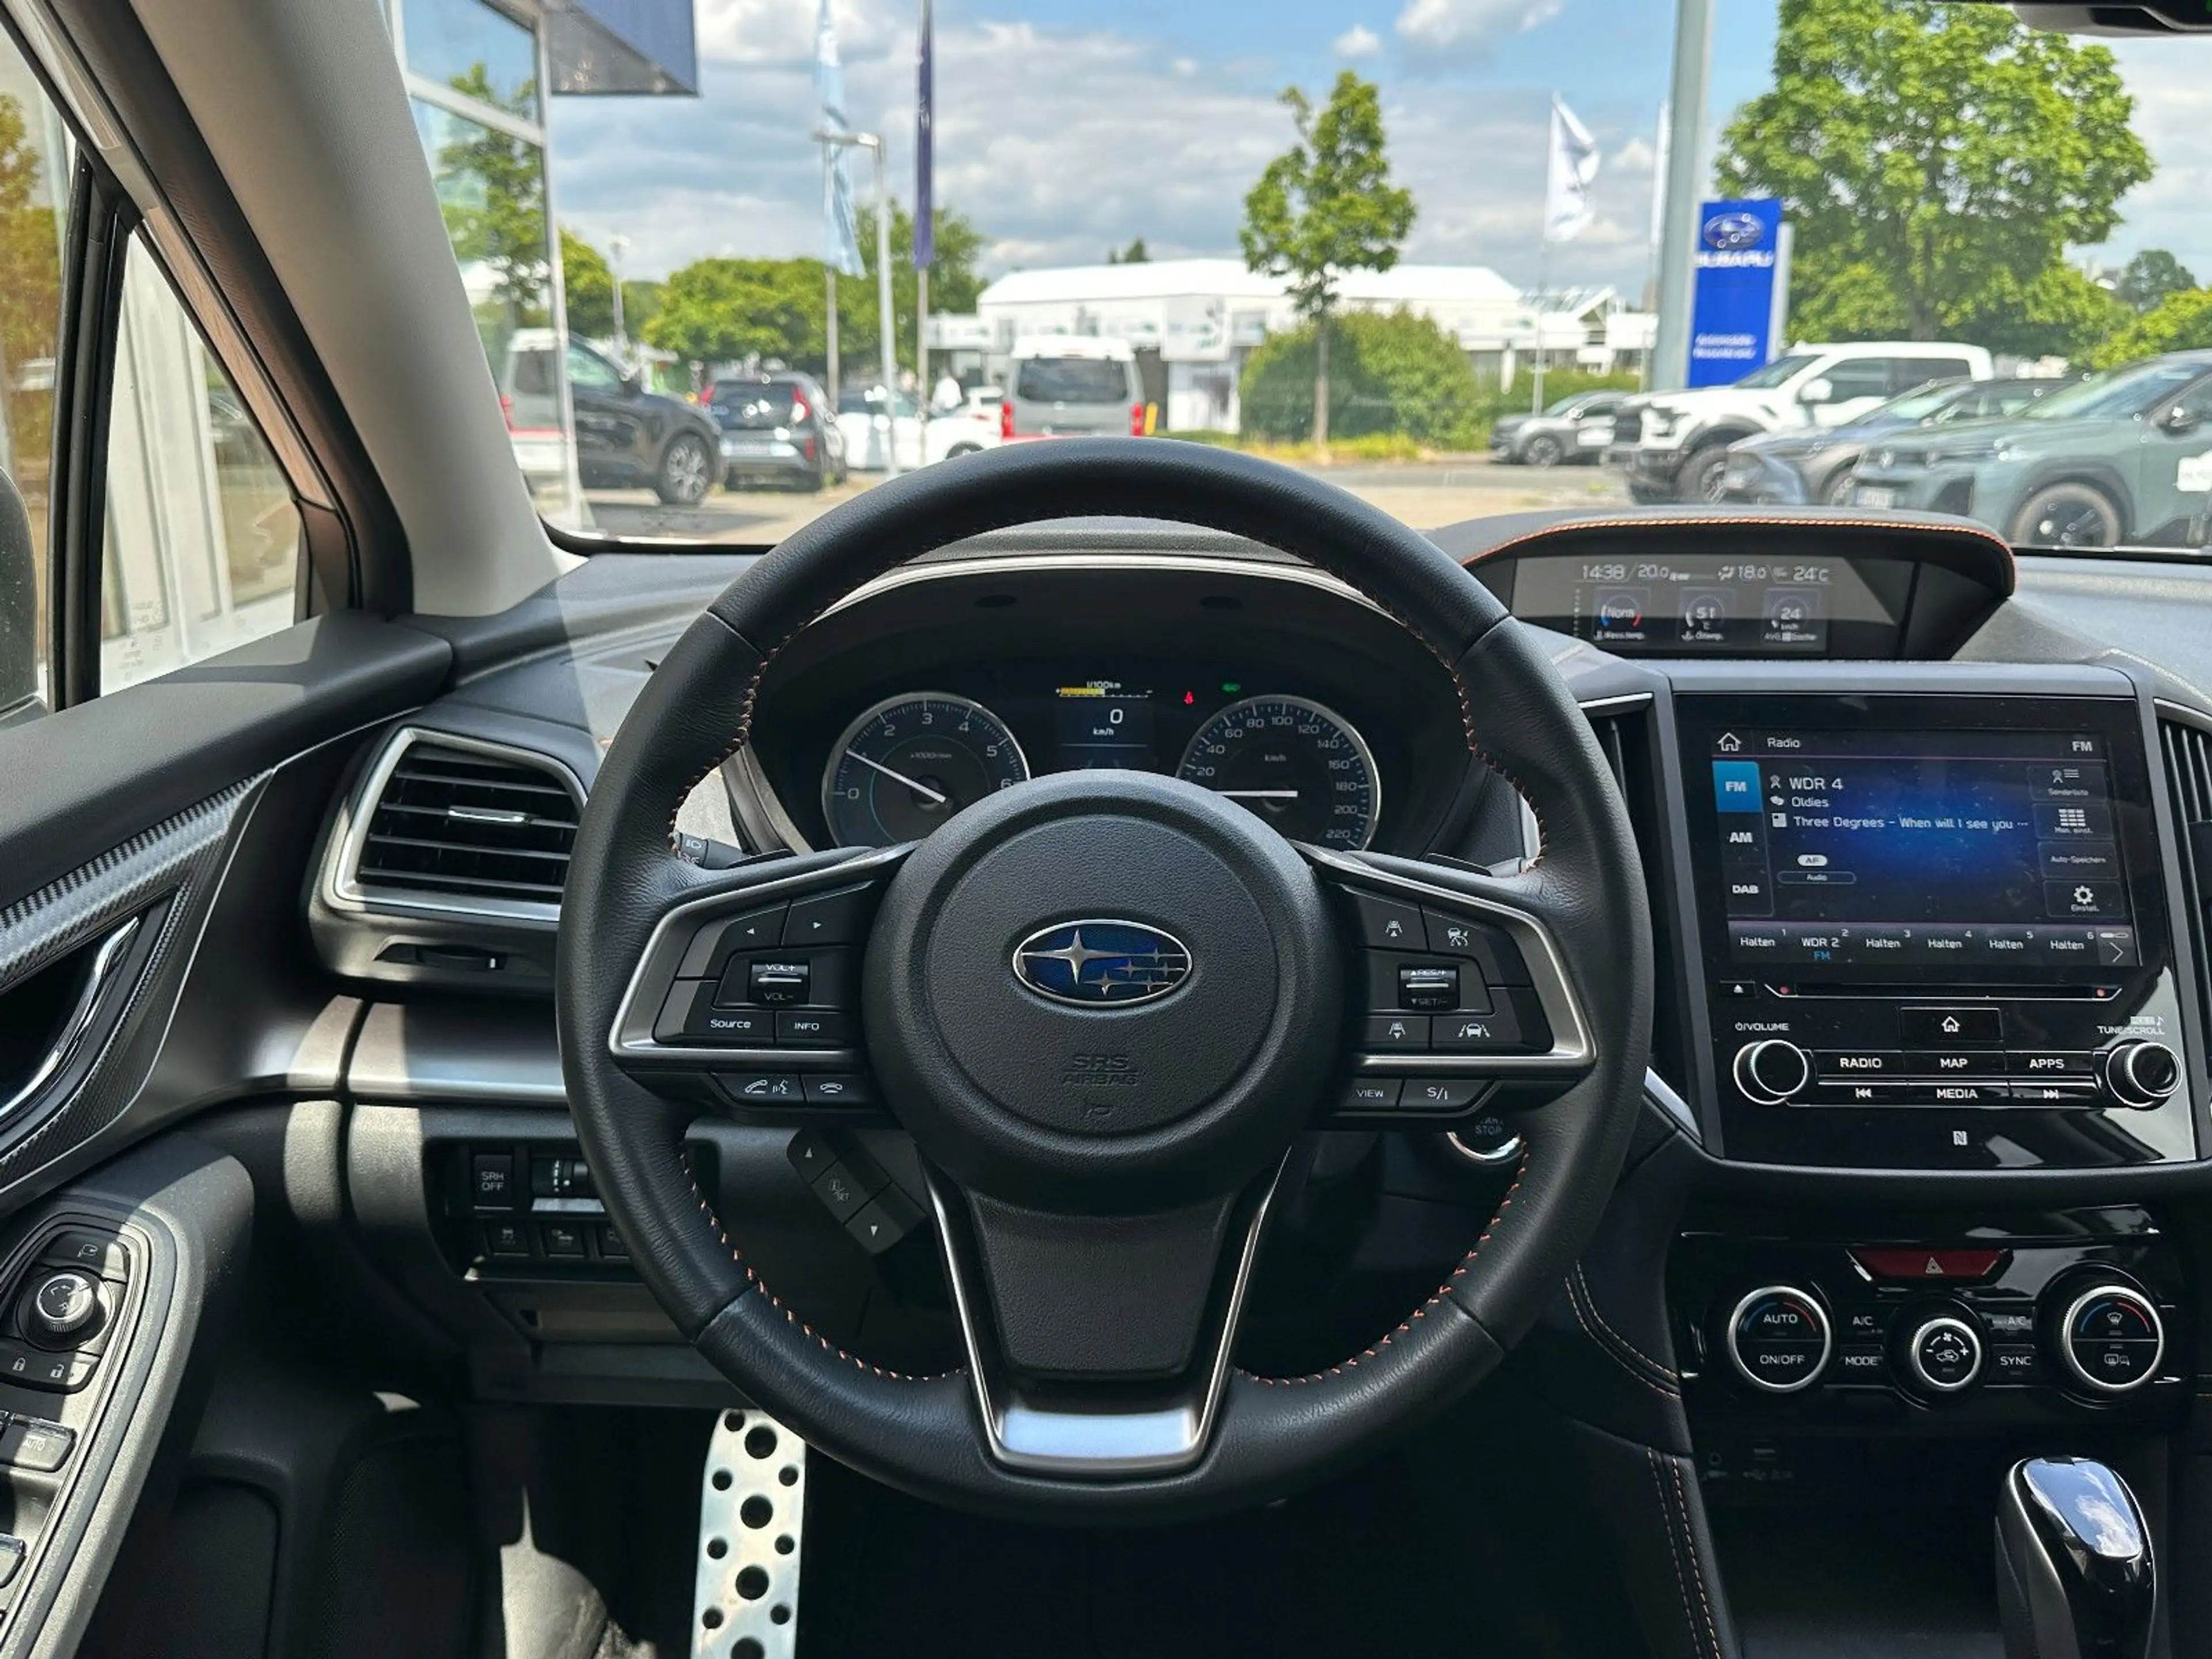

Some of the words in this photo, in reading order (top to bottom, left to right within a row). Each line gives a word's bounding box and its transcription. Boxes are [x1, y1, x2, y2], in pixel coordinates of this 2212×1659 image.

[1781, 607, 1802, 620] 24
[923, 713, 933, 724] 3
[1110, 709, 1123, 724] 0
[1271, 717, 1293, 725] 100
[959, 722, 969, 732] 4
[1247, 719, 1264, 728] 80
[884, 725, 896, 736] 2
[1093, 728, 1114, 736] km/h
[1225, 729, 1243, 738] 60
[1298, 725, 1320, 734] 120
[1317, 740, 1339, 749] 140
[1767, 737, 1801, 748] Radio
[2072, 741, 2093, 751] FM
[987, 745, 998, 757] 5
[1207, 745, 1225, 754] 40
[1328, 760, 1350, 769] 160
[1196, 767, 1215, 777] 20
[1336, 781, 1357, 791] 180
[1725, 781, 1747, 792] FM
[1789, 778, 1825, 790] WDR
[1831, 778, 1843, 790] 4
[847, 788, 860, 800] 0
[1791, 797, 1829, 807] Oldies
[1334, 805, 1357, 814] 200
[1793, 816, 1829, 827] Three
[1834, 817, 1885, 830] Degrees
[1899, 817, 1931, 828] When
[1936, 818, 1955, 828] will
[1966, 820, 1987, 829] see
[1992, 820, 2013, 831] you
[1326, 830, 1350, 839] 220
[1729, 832, 1753, 843] AM
[1732, 885, 1759, 894] DAB
[1904, 930, 1911, 938] 3
[2026, 931, 2033, 939] 5
[2087, 931, 2094, 940] 6
[1740, 937, 1775, 946] Halten
[1801, 938, 1827, 947] WDR
[1831, 938, 1840, 948] 2
[1866, 938, 1900, 948] Halten
[1928, 939, 1962, 948] Halten
[1989, 940, 2023, 949] Halten
[2050, 940, 2084, 950] Halten
[1814, 951, 1830, 960] FM
[710, 1018, 751, 1028] Source
[794, 1021, 820, 1031] INFO
[1072, 1055, 1129, 1071] SRS
[1839, 1058, 1882, 1068] RADIO
[1940, 1058, 1968, 1068] MAP
[2029, 1059, 2065, 1069] APPS
[1357, 1089, 1384, 1097] VIEW
[1936, 1088, 1979, 1099] MEDIA
[1475, 1125, 1503, 1135] STOP
[481, 1171, 504, 1180] SRH
[482, 1181, 504, 1191] OFF
[1763, 1314, 1798, 1324] AUTO
[1853, 1316, 1873, 1325] A/C
[1759, 1354, 1805, 1365] ON/OFF
[1845, 1355, 1878, 1365] MODE
[1999, 1355, 2032, 1366] SYNC
